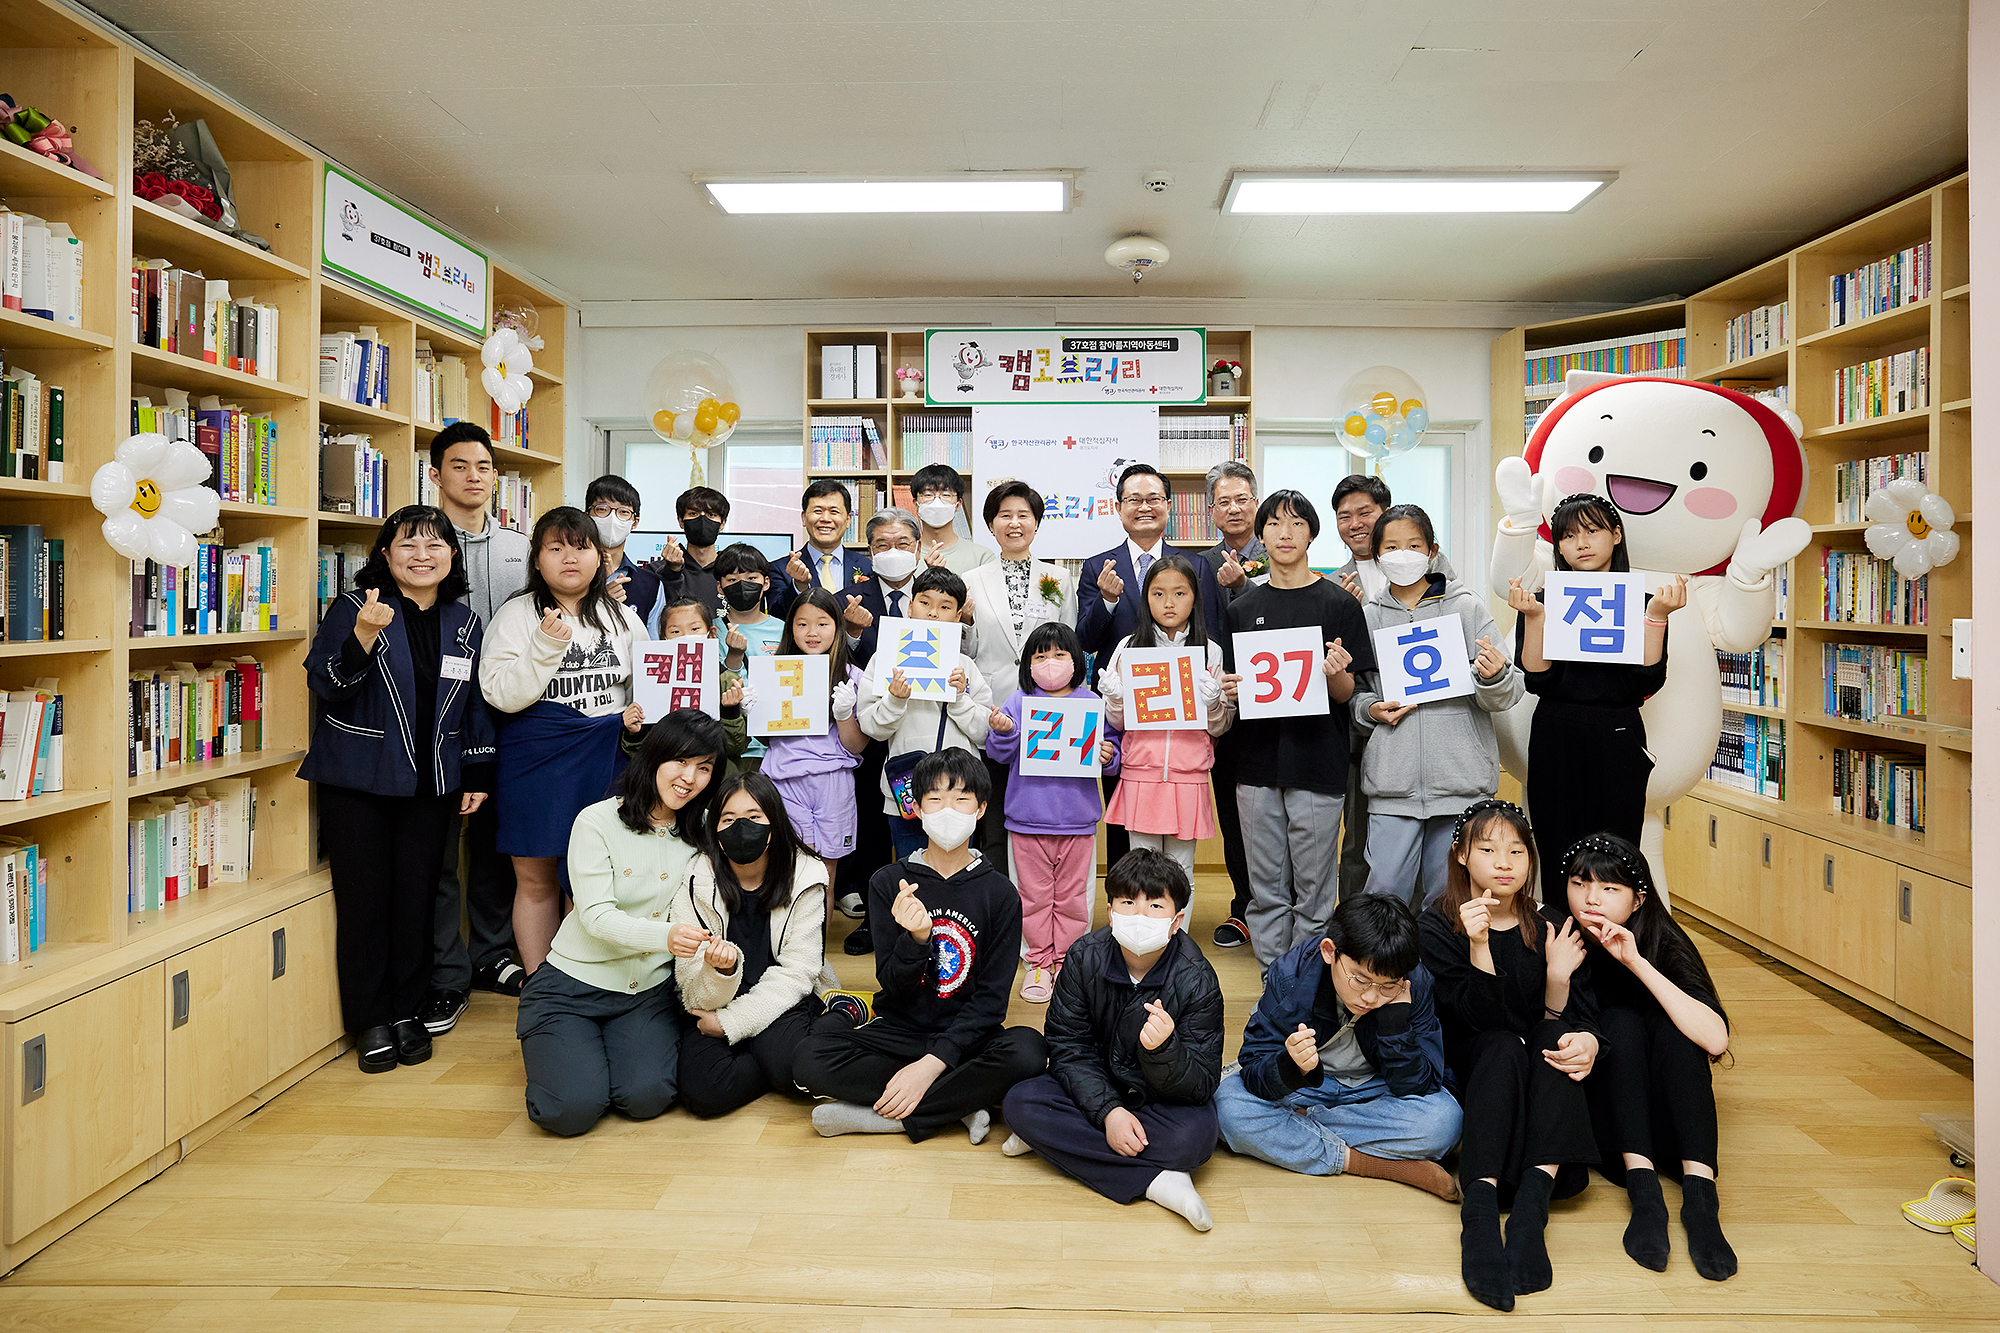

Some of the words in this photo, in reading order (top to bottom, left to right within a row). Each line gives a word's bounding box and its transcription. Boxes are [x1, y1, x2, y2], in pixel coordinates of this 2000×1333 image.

[1069, 340, 1097, 350] 37호점
[1098, 340, 1171, 350] 참아름지역아동센터
[989, 439, 1005, 450] 캠코
[1011, 439, 1057, 447] 한국자산관리공사
[1078, 436, 1119, 444] 대한적십자사
[261, 441, 269, 478] POLITICS
[200, 546, 208, 575] THINK
[1562, 583, 1627, 654] 점
[1249, 650, 1314, 704] 37
[1397, 626, 1450, 696] 호
[767, 659, 811, 732] 코
[1026, 709, 1099, 767] 러
[944, 908, 980, 938] AMERICA
